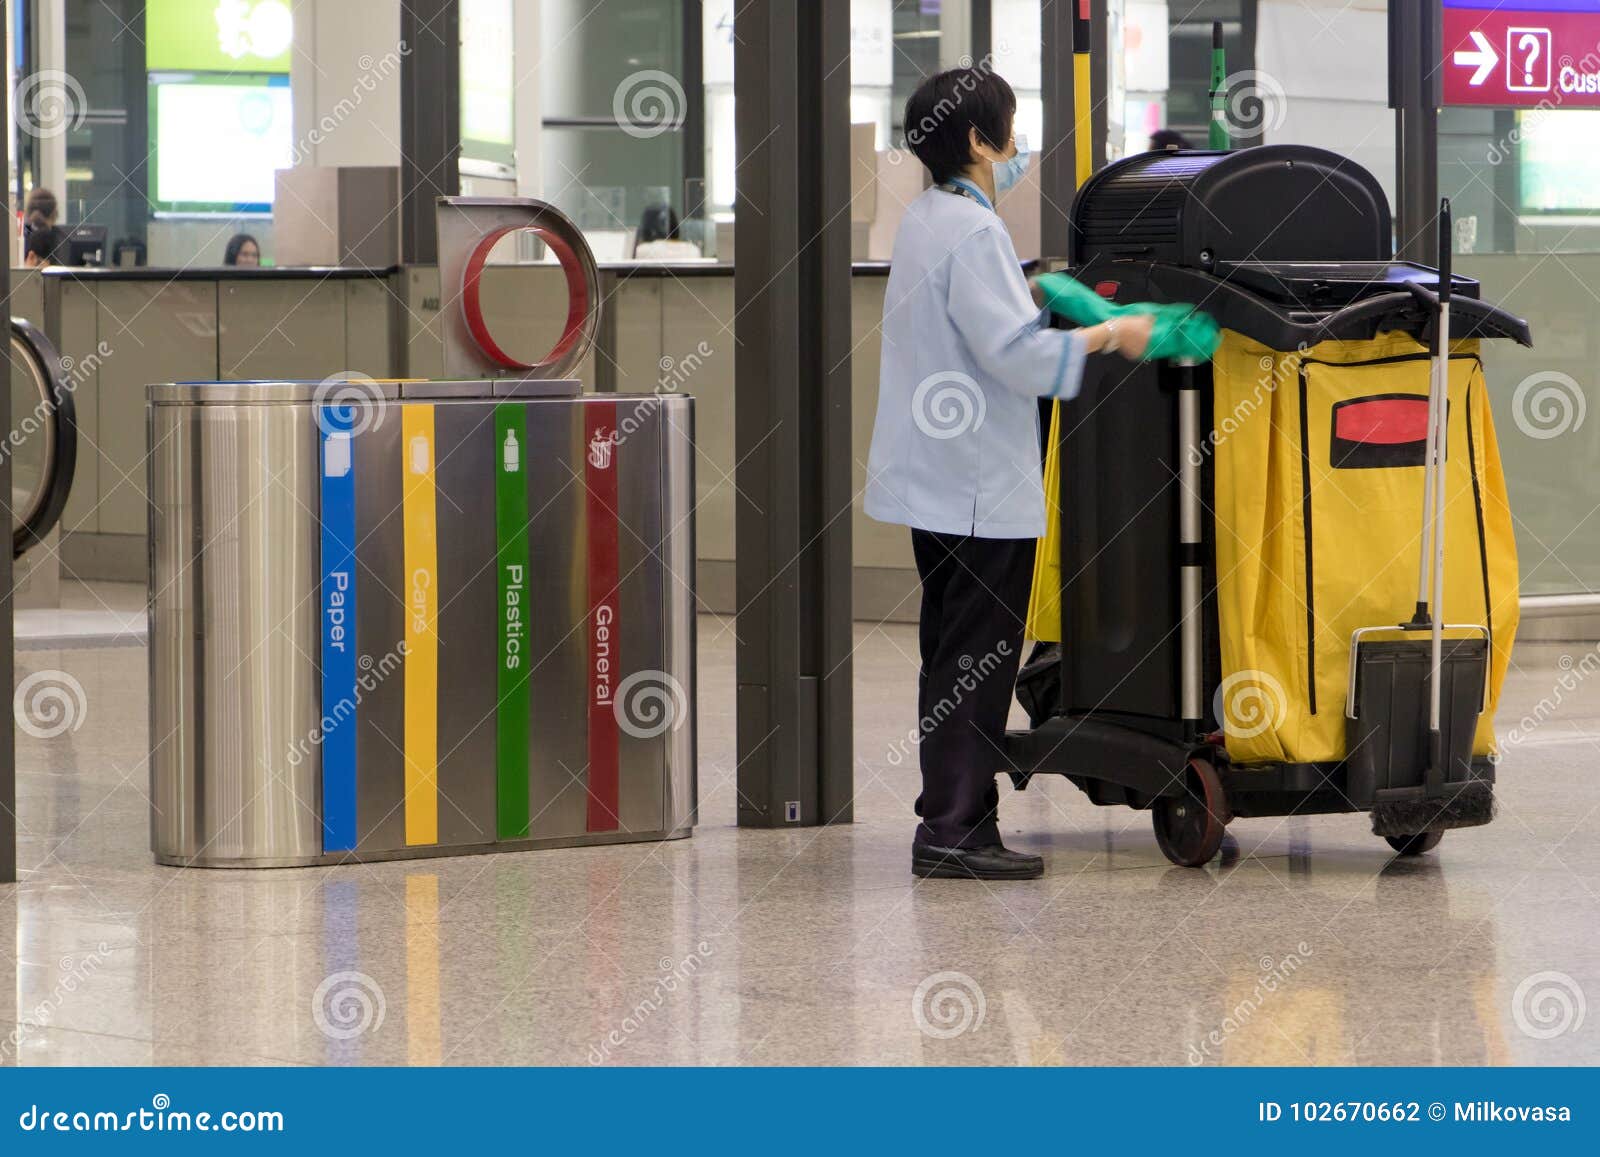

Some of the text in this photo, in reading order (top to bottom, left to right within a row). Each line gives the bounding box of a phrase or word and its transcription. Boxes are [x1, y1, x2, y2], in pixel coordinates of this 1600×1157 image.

[327, 572, 349, 652] Paper
[413, 568, 430, 634] Cans
[506, 564, 524, 670] Plastics
[596, 605, 613, 706] General
